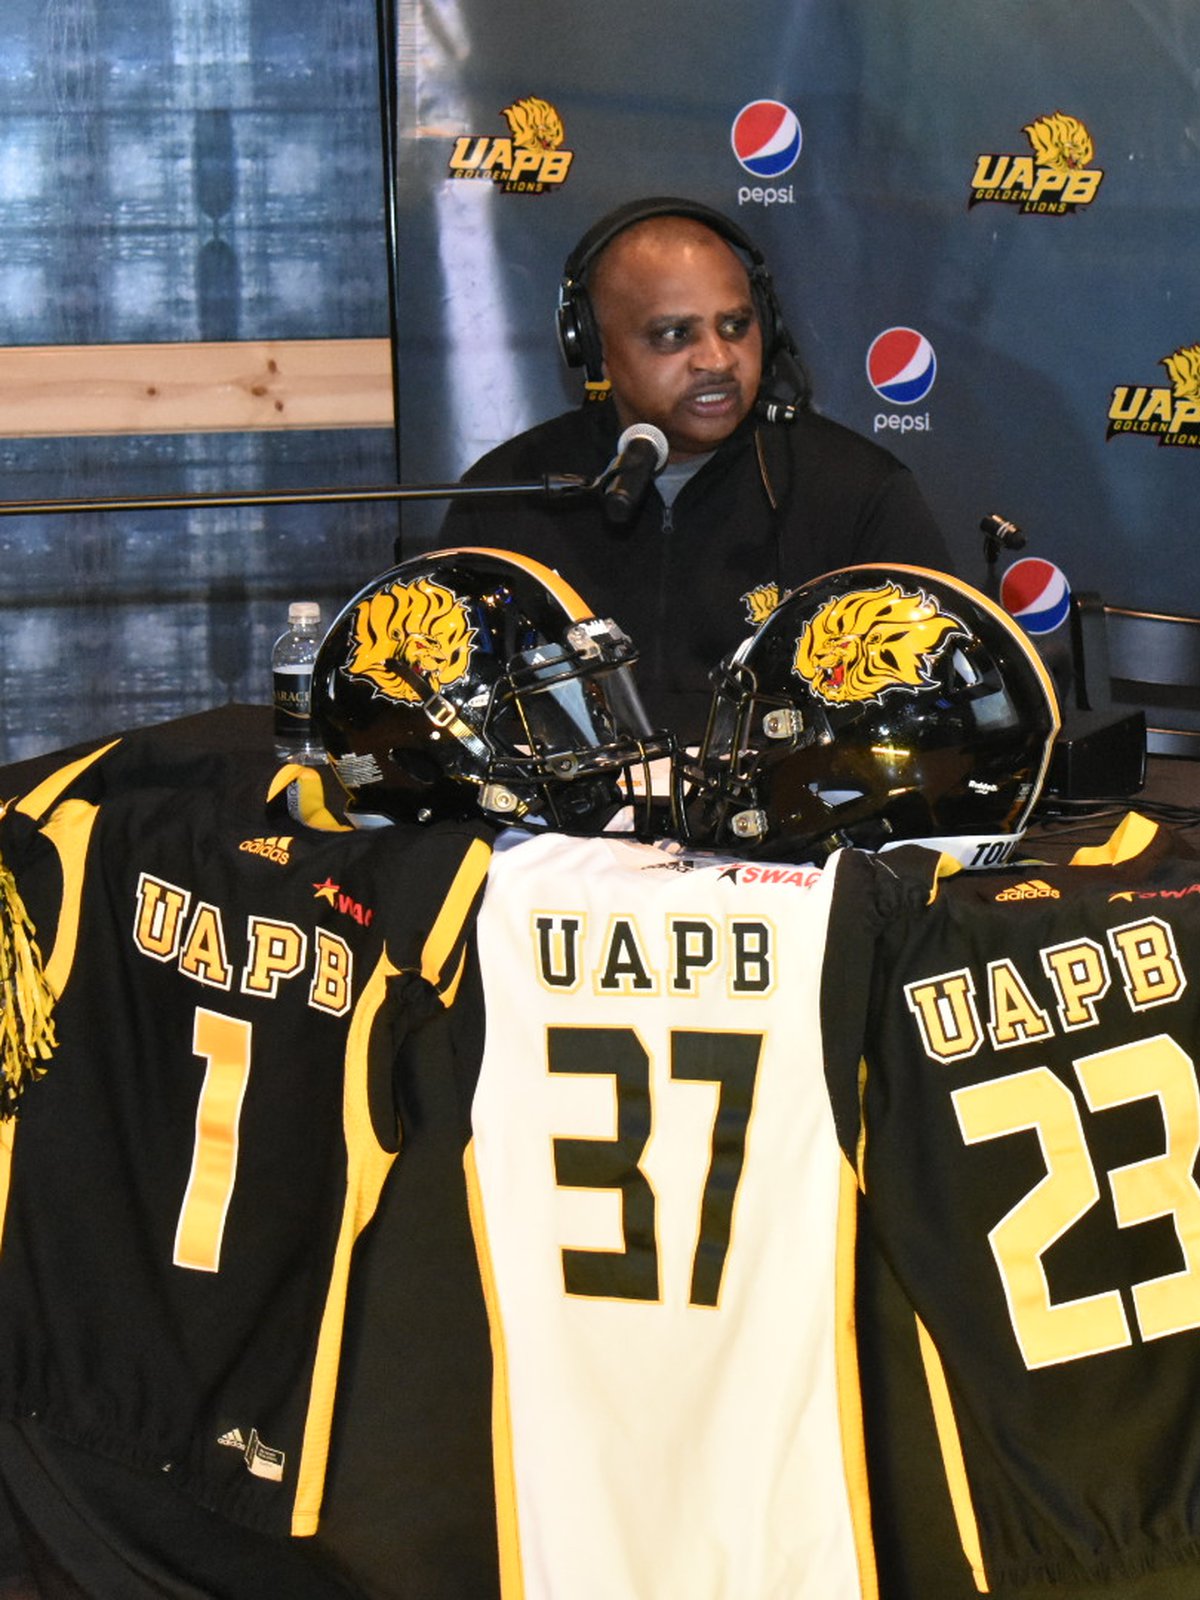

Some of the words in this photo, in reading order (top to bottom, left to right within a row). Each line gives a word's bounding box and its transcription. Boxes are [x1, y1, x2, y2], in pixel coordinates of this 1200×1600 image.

[449, 137, 573, 183] UAPB
[506, 181, 543, 192] LIONS
[971, 155, 1102, 203] UAPB
[738, 185, 794, 207] pepsi
[975, 189, 1031, 201] GOLDEN
[1024, 201, 1068, 213] LIONS
[874, 411, 931, 435] pepsi
[1113, 420, 1169, 432] GOLDEN
[239, 839, 290, 865] adidas
[995, 888, 1061, 902] adidas
[134, 872, 353, 1016] UAPB
[530, 910, 776, 998] UAPB
[903, 916, 1188, 1063] UAPB
[173, 1006, 252, 1273] 1
[544, 1023, 767, 1310] 37
